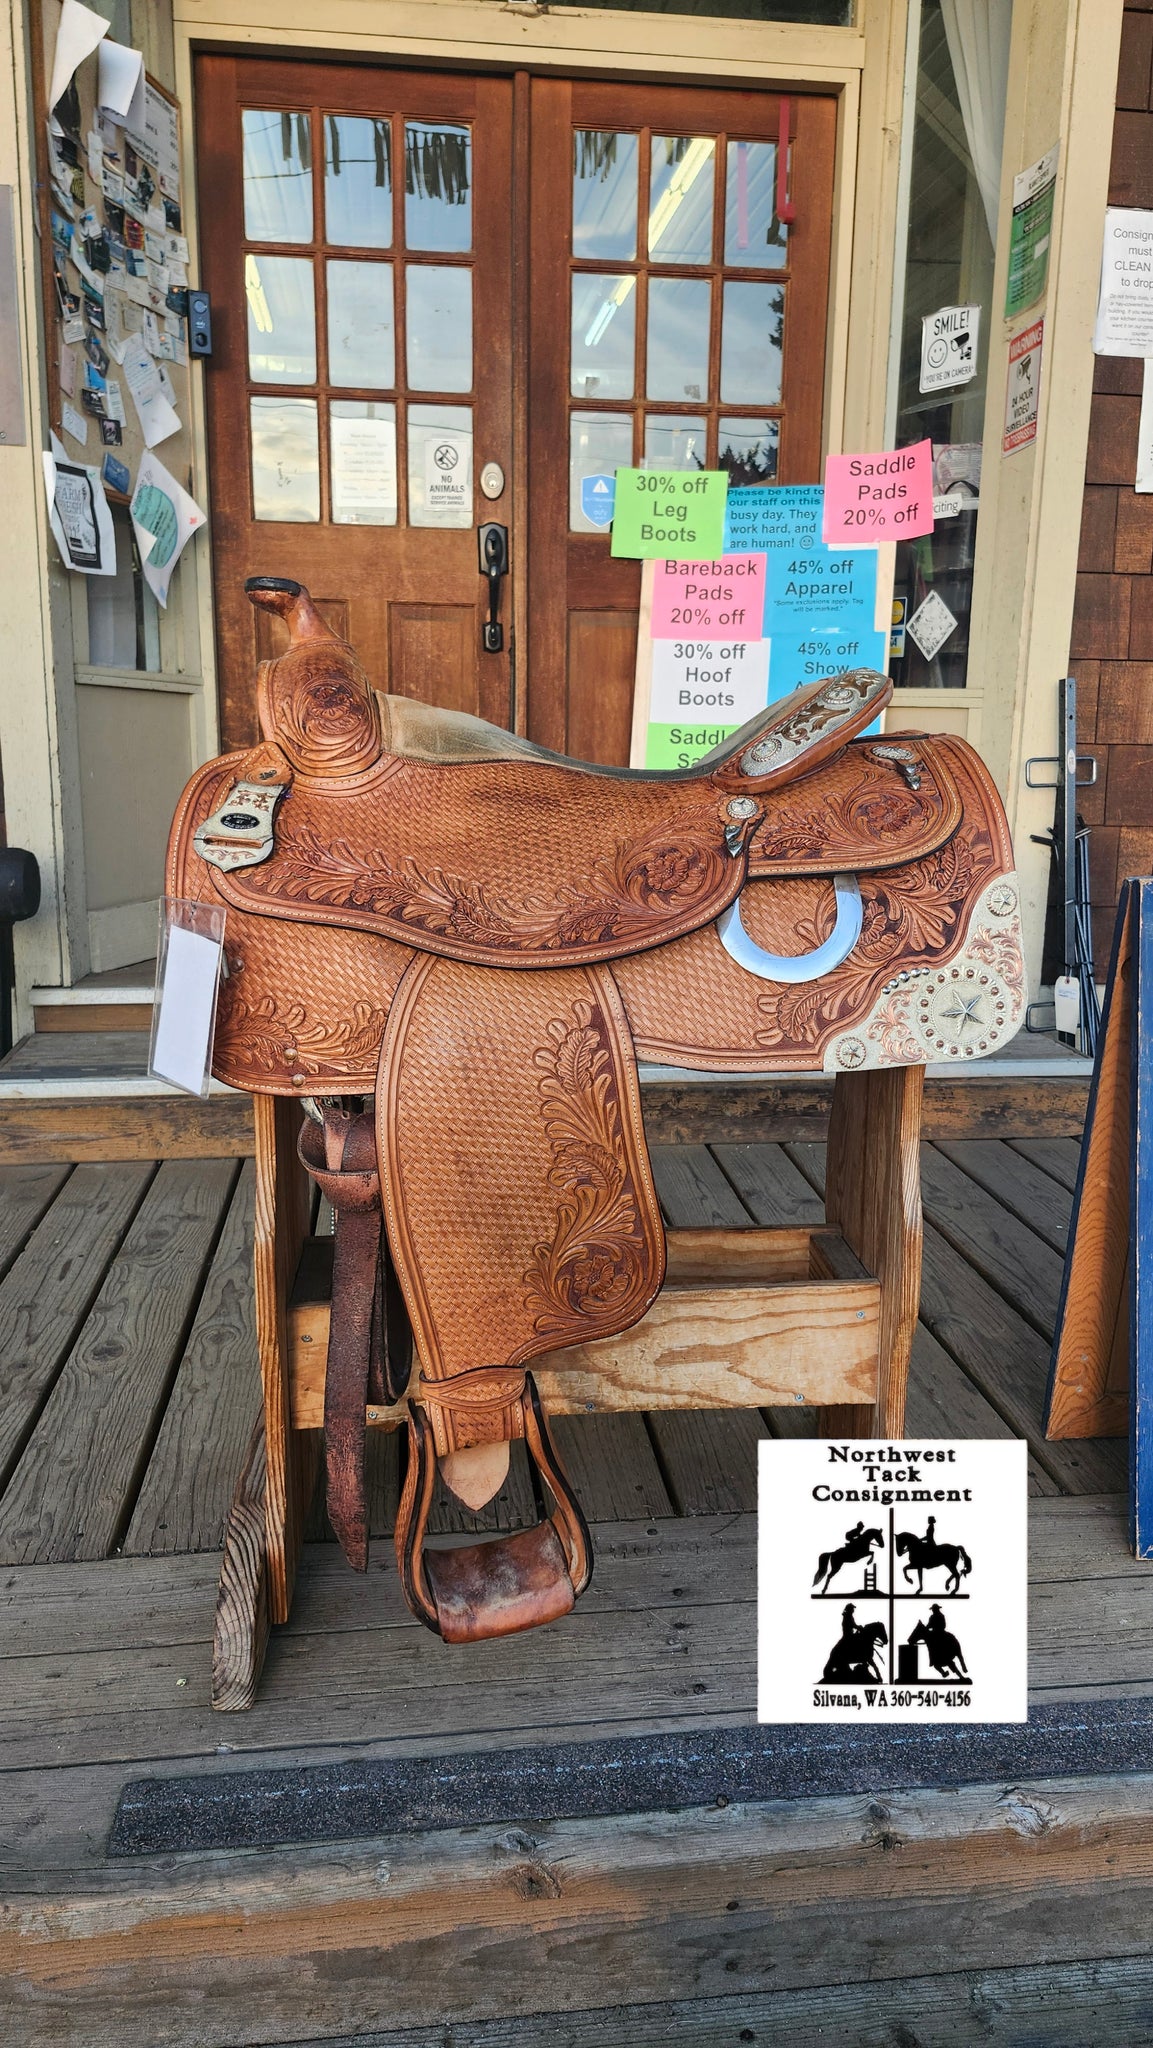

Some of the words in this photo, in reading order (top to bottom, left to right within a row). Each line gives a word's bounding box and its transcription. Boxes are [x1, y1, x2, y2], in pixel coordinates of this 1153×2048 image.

[1128, 247, 1152, 256] must
[1114, 260, 1151, 272] CLEAN
[1121, 277, 1130, 287] to
[1133, 277, 1153, 291] drop
[934, 310, 970, 336] SMILE!
[944, 370, 950, 379] ON
[1014, 402, 1030, 419] VIDEO
[849, 455, 916, 477] Saddle
[441, 475, 453, 484] NO
[636, 475, 676, 494] 30%
[682, 477, 710, 494] off
[430, 485, 465, 493] ANIMALS
[727, 489, 764, 497] Please
[768, 488, 781, 496] be
[785, 488, 810, 496] kind
[858, 483, 908, 501] Pads
[751, 498, 778, 506] staff
[799, 497, 821, 506] this
[933, 500, 959, 514] citing
[653, 501, 688, 521] Leg
[730, 510, 759, 522] busy
[762, 510, 785, 521] day.
[789, 509, 818, 521] They
[843, 508, 886, 526] 20%
[894, 502, 919, 524] off
[641, 524, 697, 542] Boots
[729, 524, 758, 534] work
[761, 524, 791, 535] hard,
[795, 523, 817, 533] and
[729, 540, 748, 548] are
[751, 538, 794, 548] human!
[664, 560, 758, 576] Bareback
[787, 560, 824, 575] 45%
[830, 560, 854, 574] off
[685, 584, 734, 601] Pads
[785, 580, 853, 599] Apparel
[670, 608, 711, 625] 20%
[719, 609, 746, 625] off
[673, 643, 713, 660] 30%
[720, 643, 747, 660] off
[797, 642, 831, 656] 45%
[836, 642, 860, 655] off
[686, 666, 732, 683] Hoof
[804, 662, 850, 675] Show
[678, 690, 735, 707] Boots
[669, 728, 725, 746] Saddl
